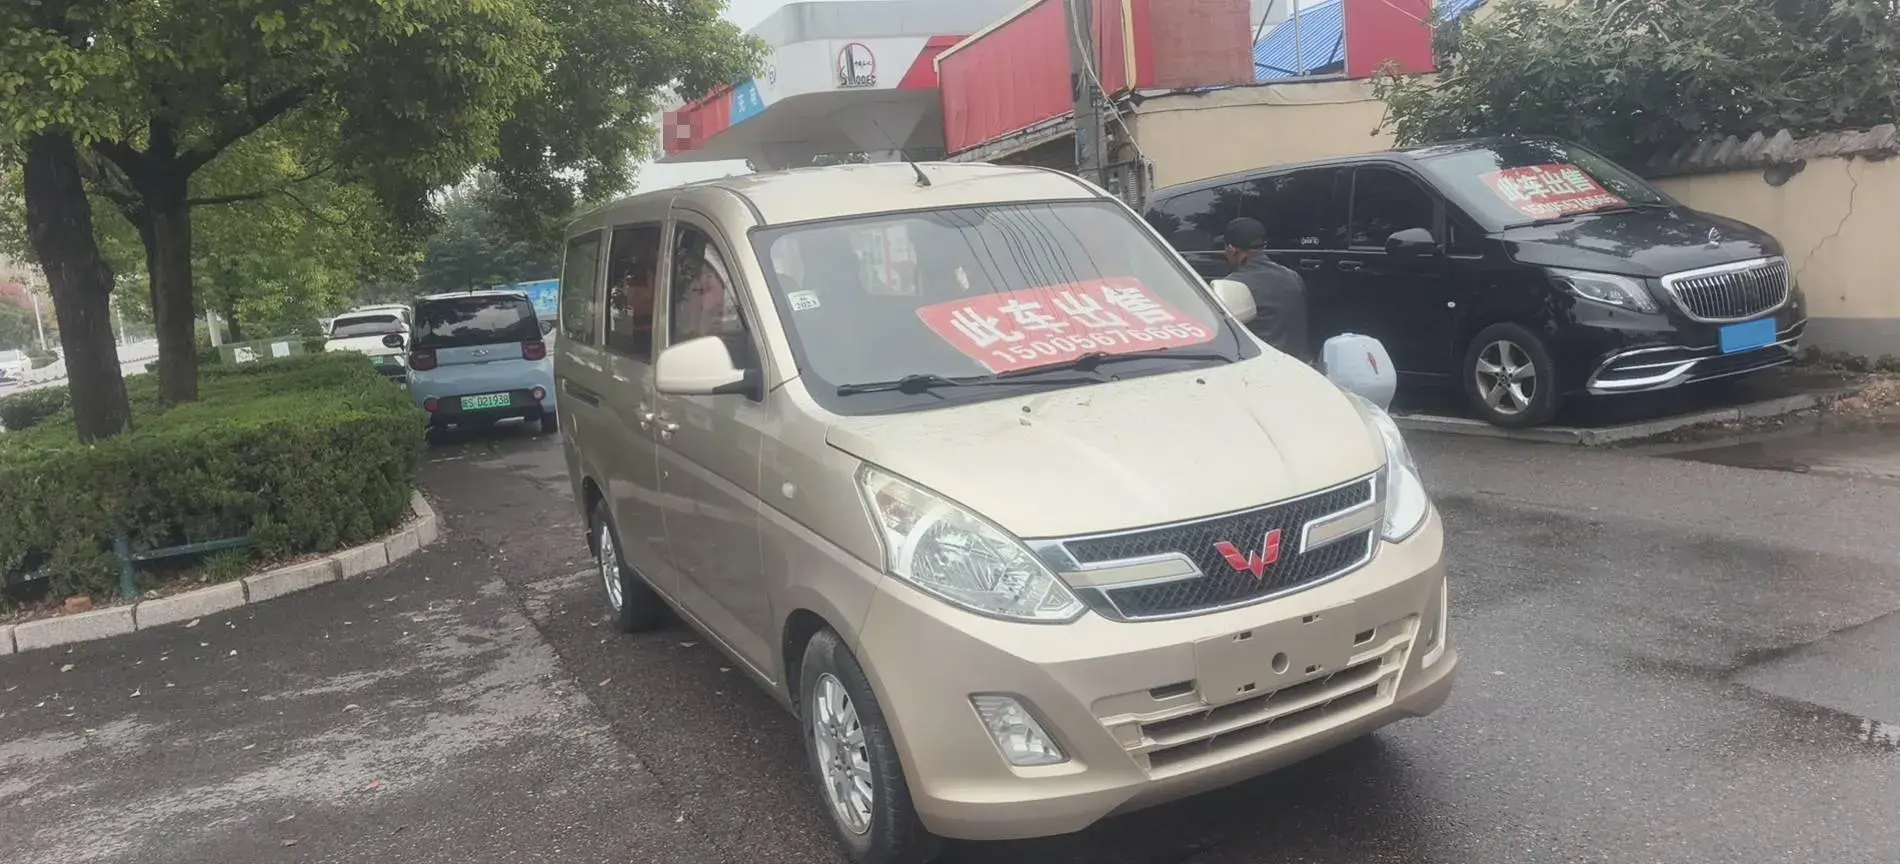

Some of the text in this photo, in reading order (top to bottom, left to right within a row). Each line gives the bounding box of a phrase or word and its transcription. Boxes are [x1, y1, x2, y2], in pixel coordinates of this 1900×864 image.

[1497, 168, 1596, 202] 此车出售
[950, 284, 1175, 348] 此车出售
[992, 322, 1206, 364] 15005676665
